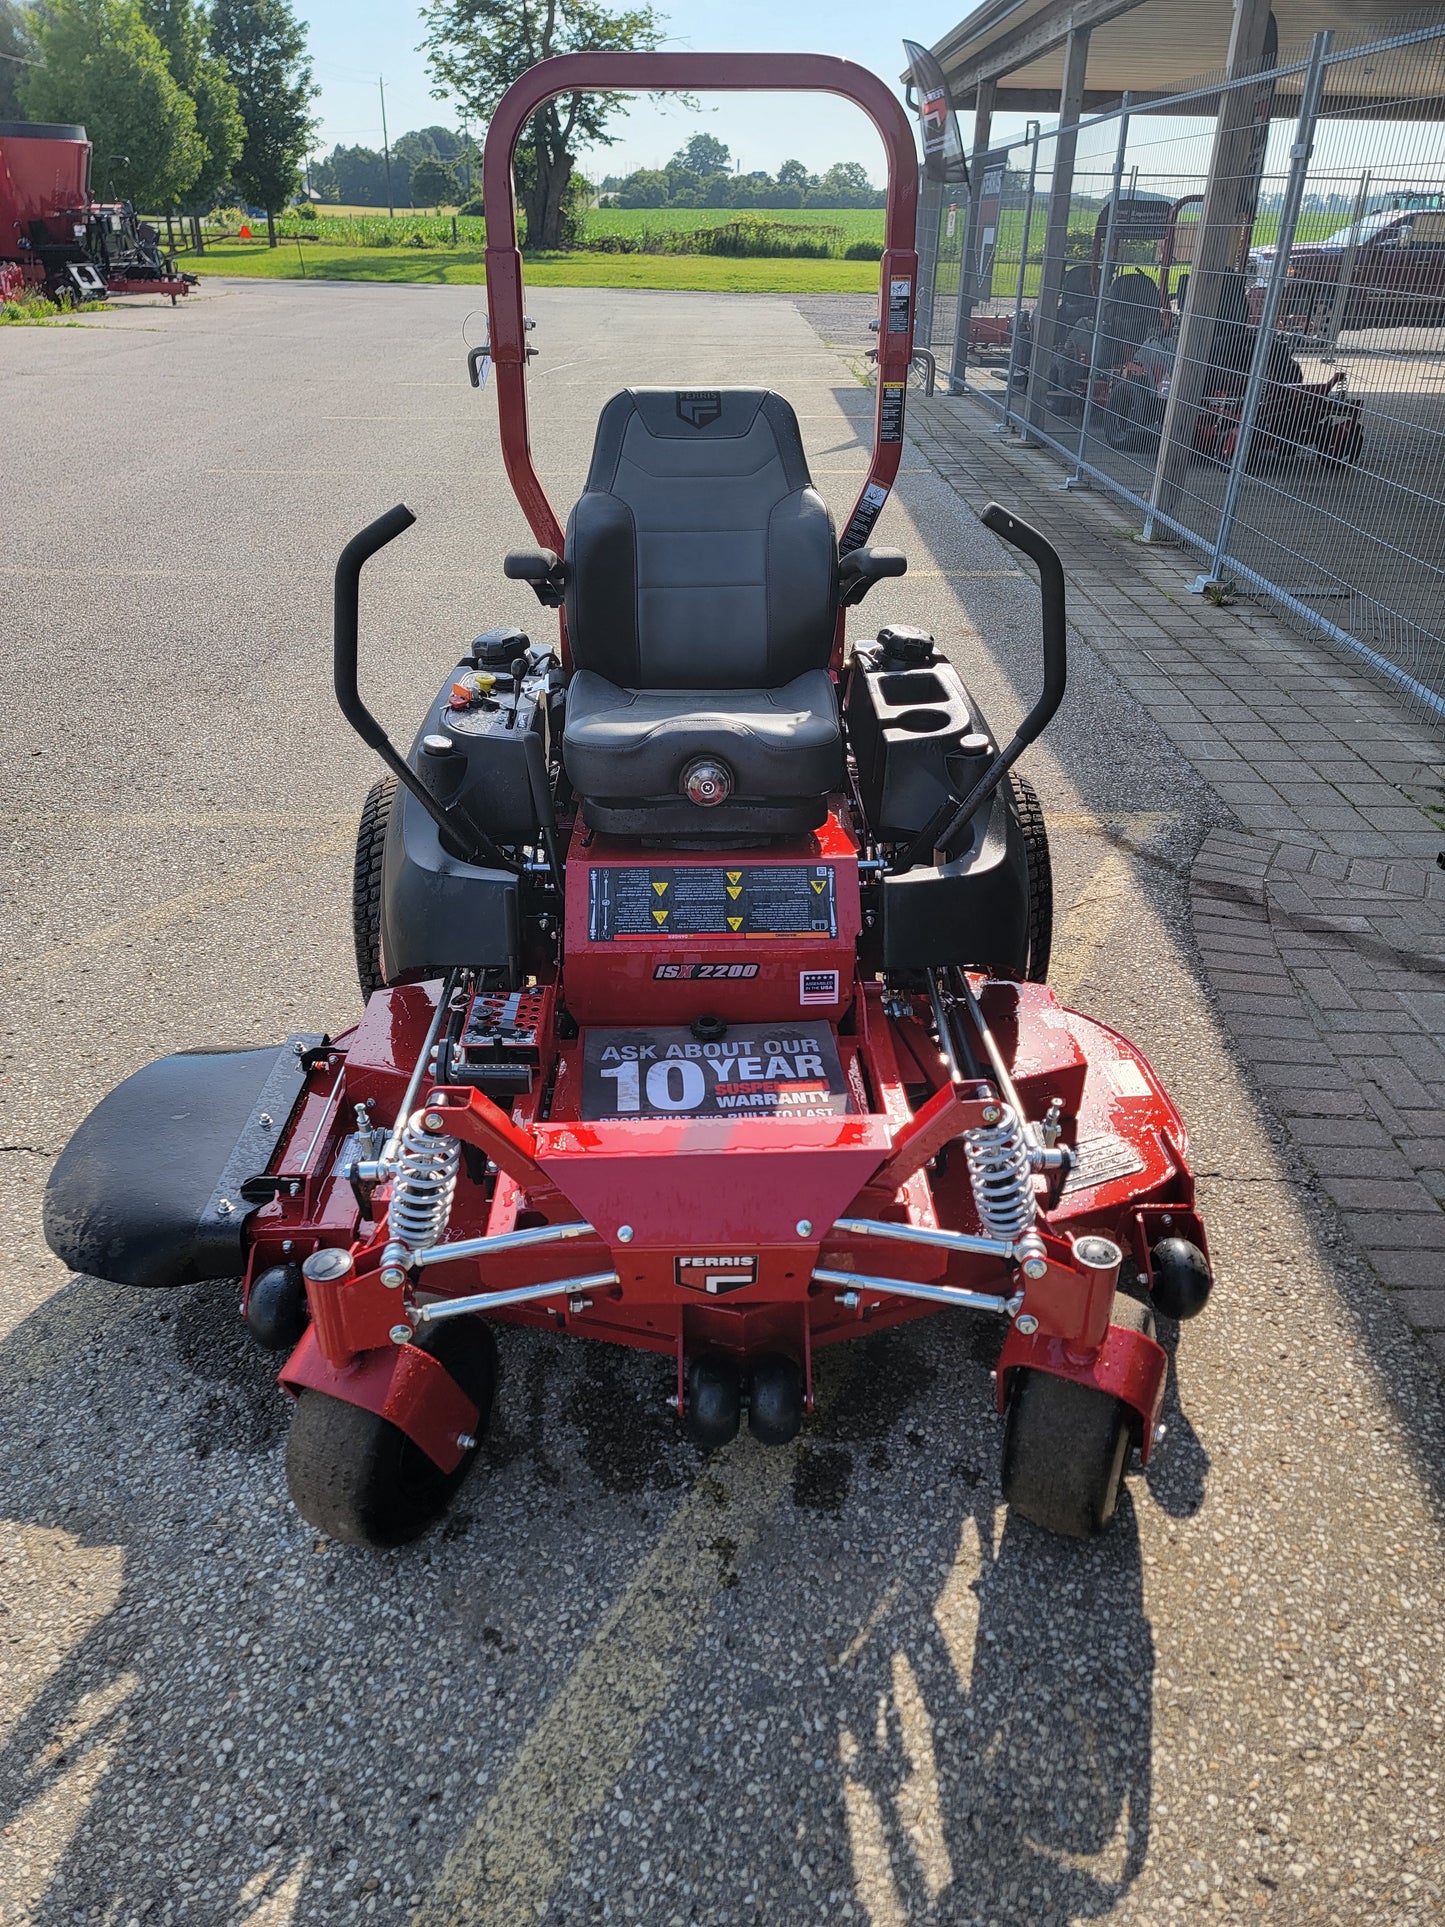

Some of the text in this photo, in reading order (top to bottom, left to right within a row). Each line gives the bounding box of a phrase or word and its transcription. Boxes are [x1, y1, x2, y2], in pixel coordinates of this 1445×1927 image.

[655, 964, 758, 979] ISX 2200
[601, 1038, 820, 1061] ASK ABOUT OUR
[706, 1054, 826, 1082] YEAR
[600, 1059, 706, 1112] 10
[714, 1079, 831, 1096] SUSPEN
[715, 1090, 831, 1109] WARRANTY
[679, 1256, 755, 1267] FERRIS
